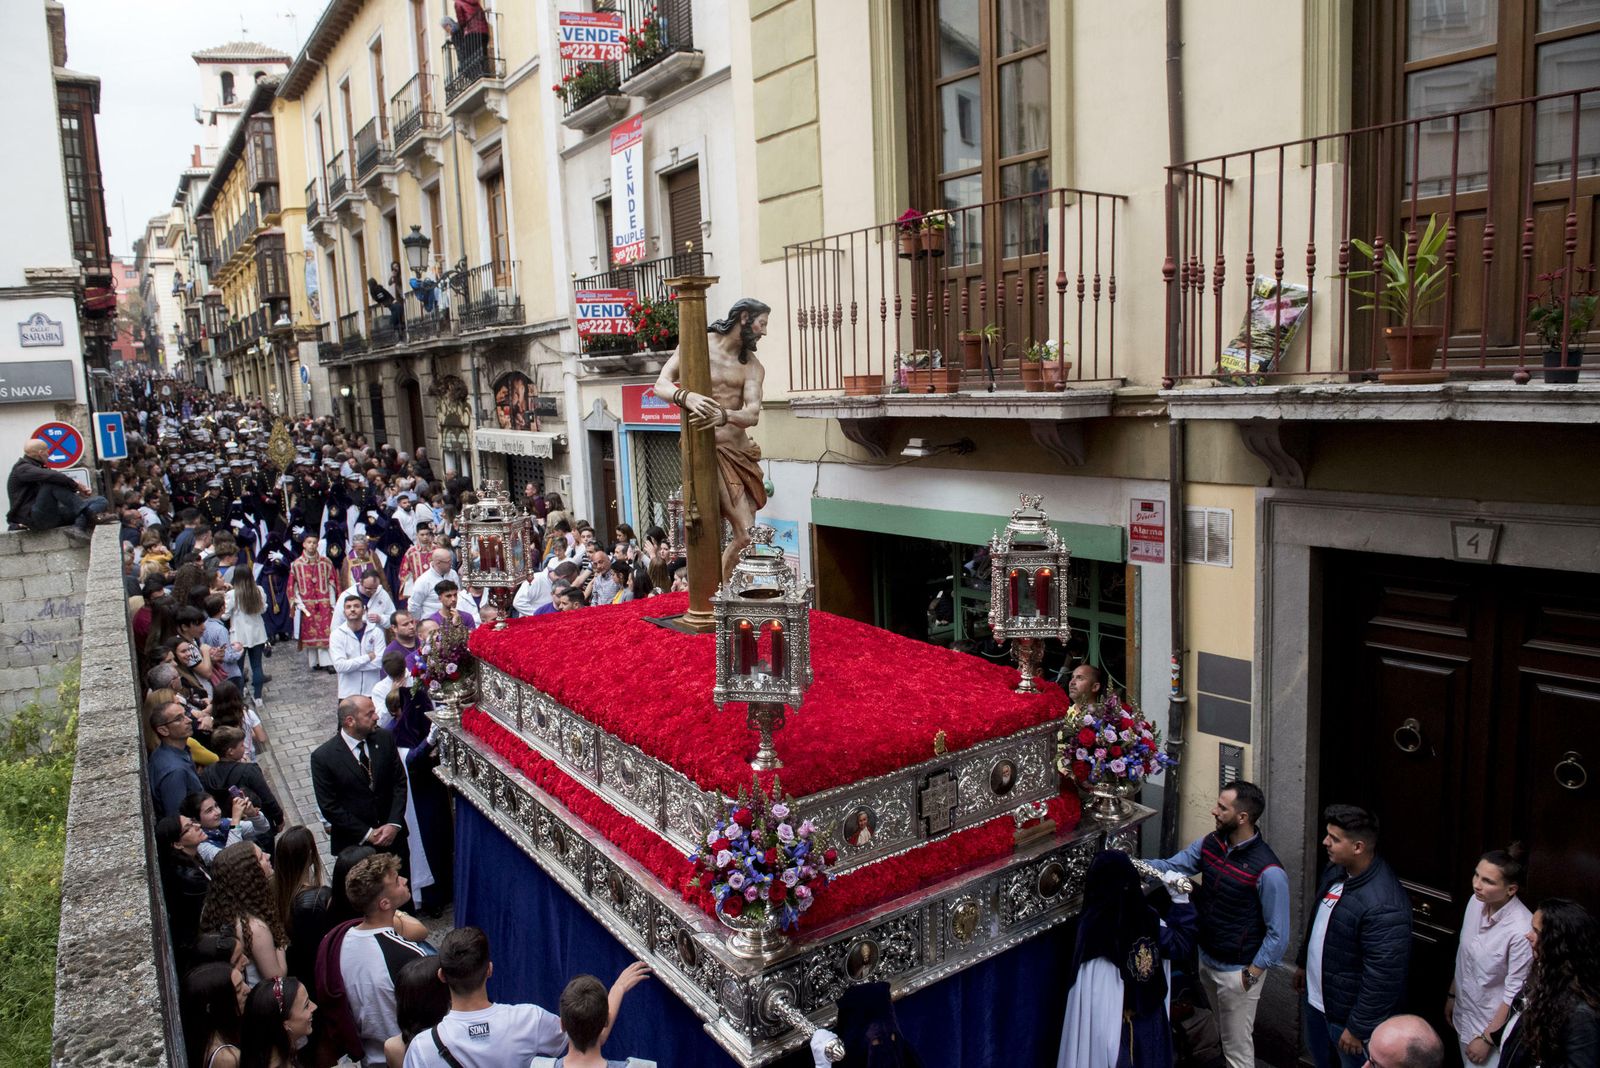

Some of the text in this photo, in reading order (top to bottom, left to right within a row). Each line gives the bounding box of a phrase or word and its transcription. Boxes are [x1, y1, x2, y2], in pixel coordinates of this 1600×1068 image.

[562, 27, 620, 43] VENDE
[572, 44, 595, 59] 222
[599, 45, 623, 60] 738
[578, 304, 626, 318] VEND
[590, 319, 612, 333] 222
[11, 385, 52, 397] NAVAS
[641, 413, 660, 421] Agencia
[1132, 525, 1163, 537] Alarma
[1467, 532, 1479, 554] 4
